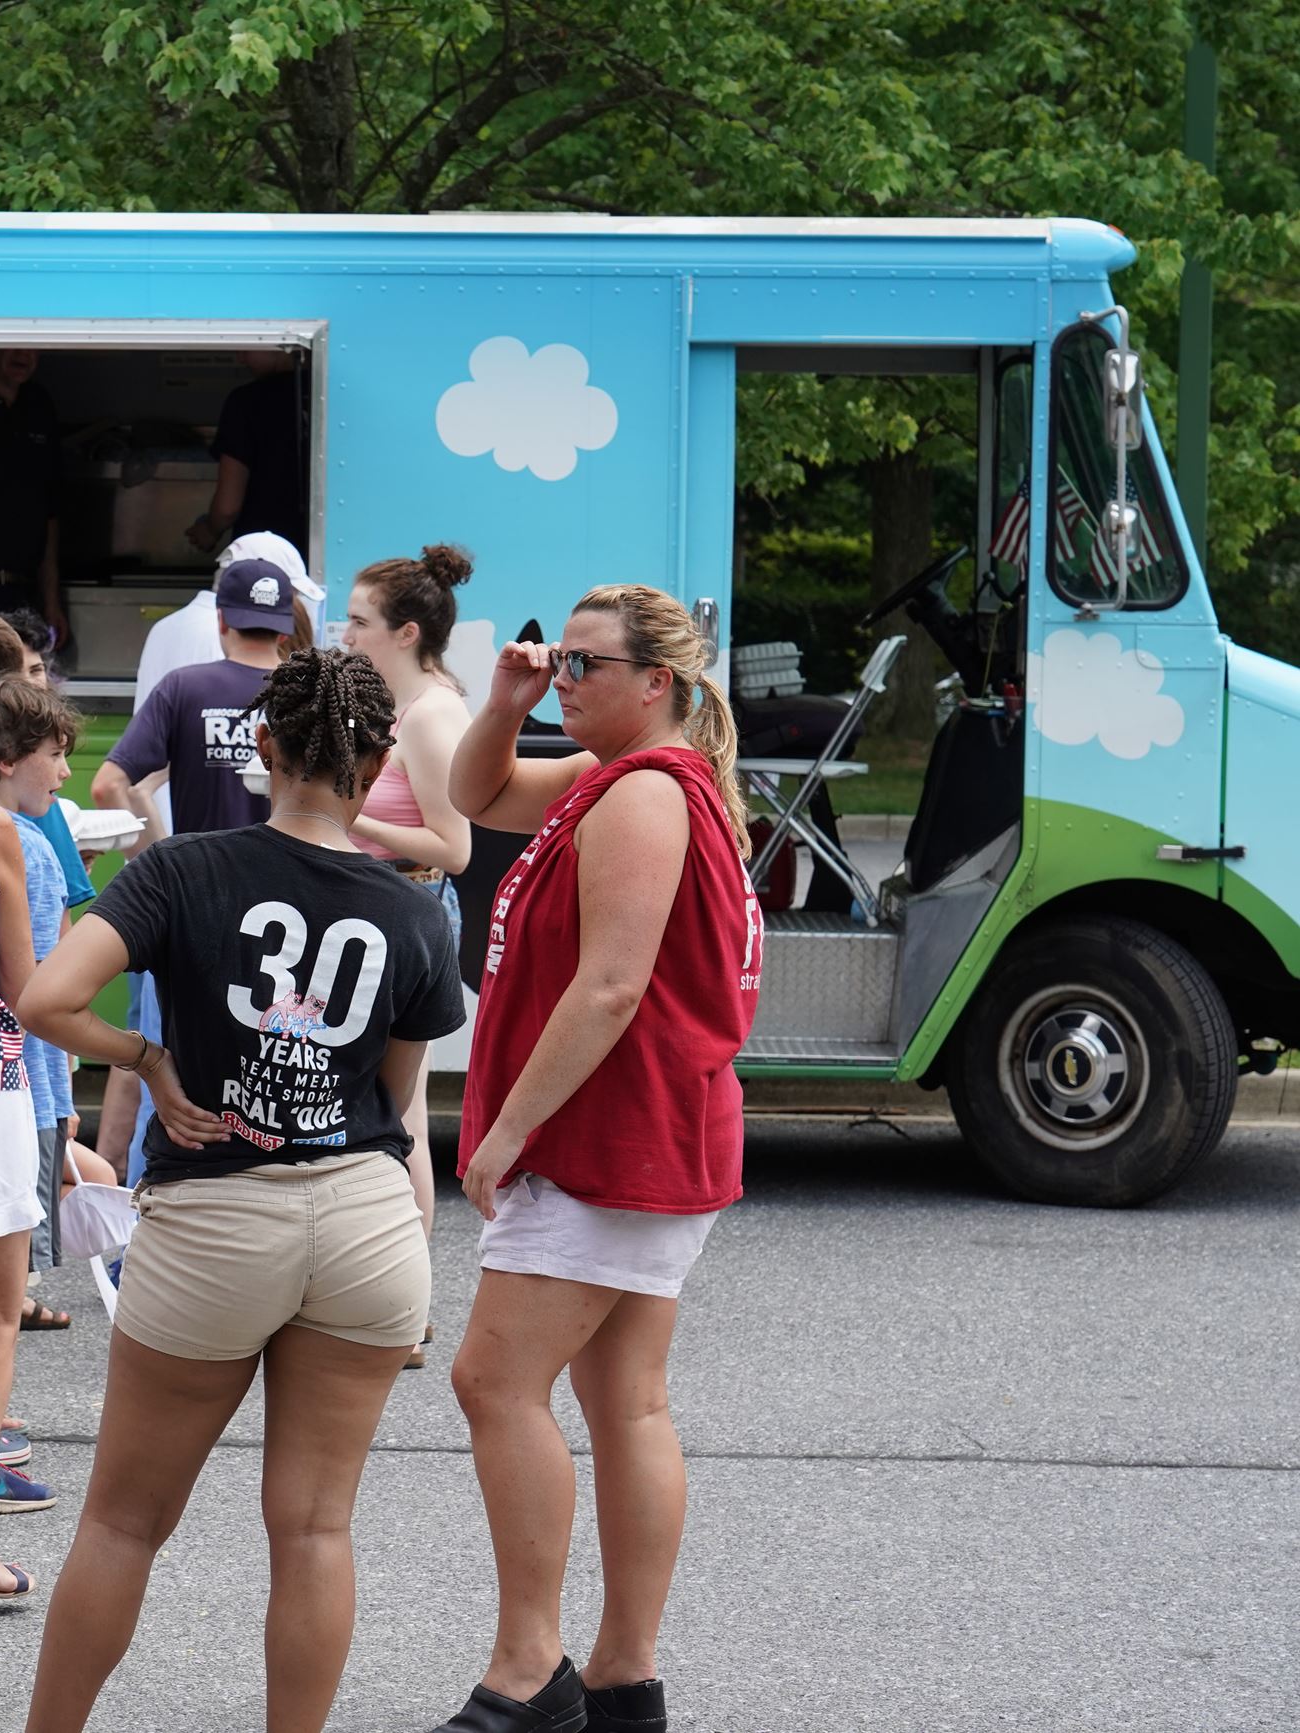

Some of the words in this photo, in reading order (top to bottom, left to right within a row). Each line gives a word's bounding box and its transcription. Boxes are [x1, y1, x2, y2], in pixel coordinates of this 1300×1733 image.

[206, 747, 233, 760] FOR
[226, 900, 388, 1048] 30
[240, 1055, 284, 1084] REAL
[259, 1033, 332, 1072] YEARS
[222, 1079, 283, 1130] REAL
